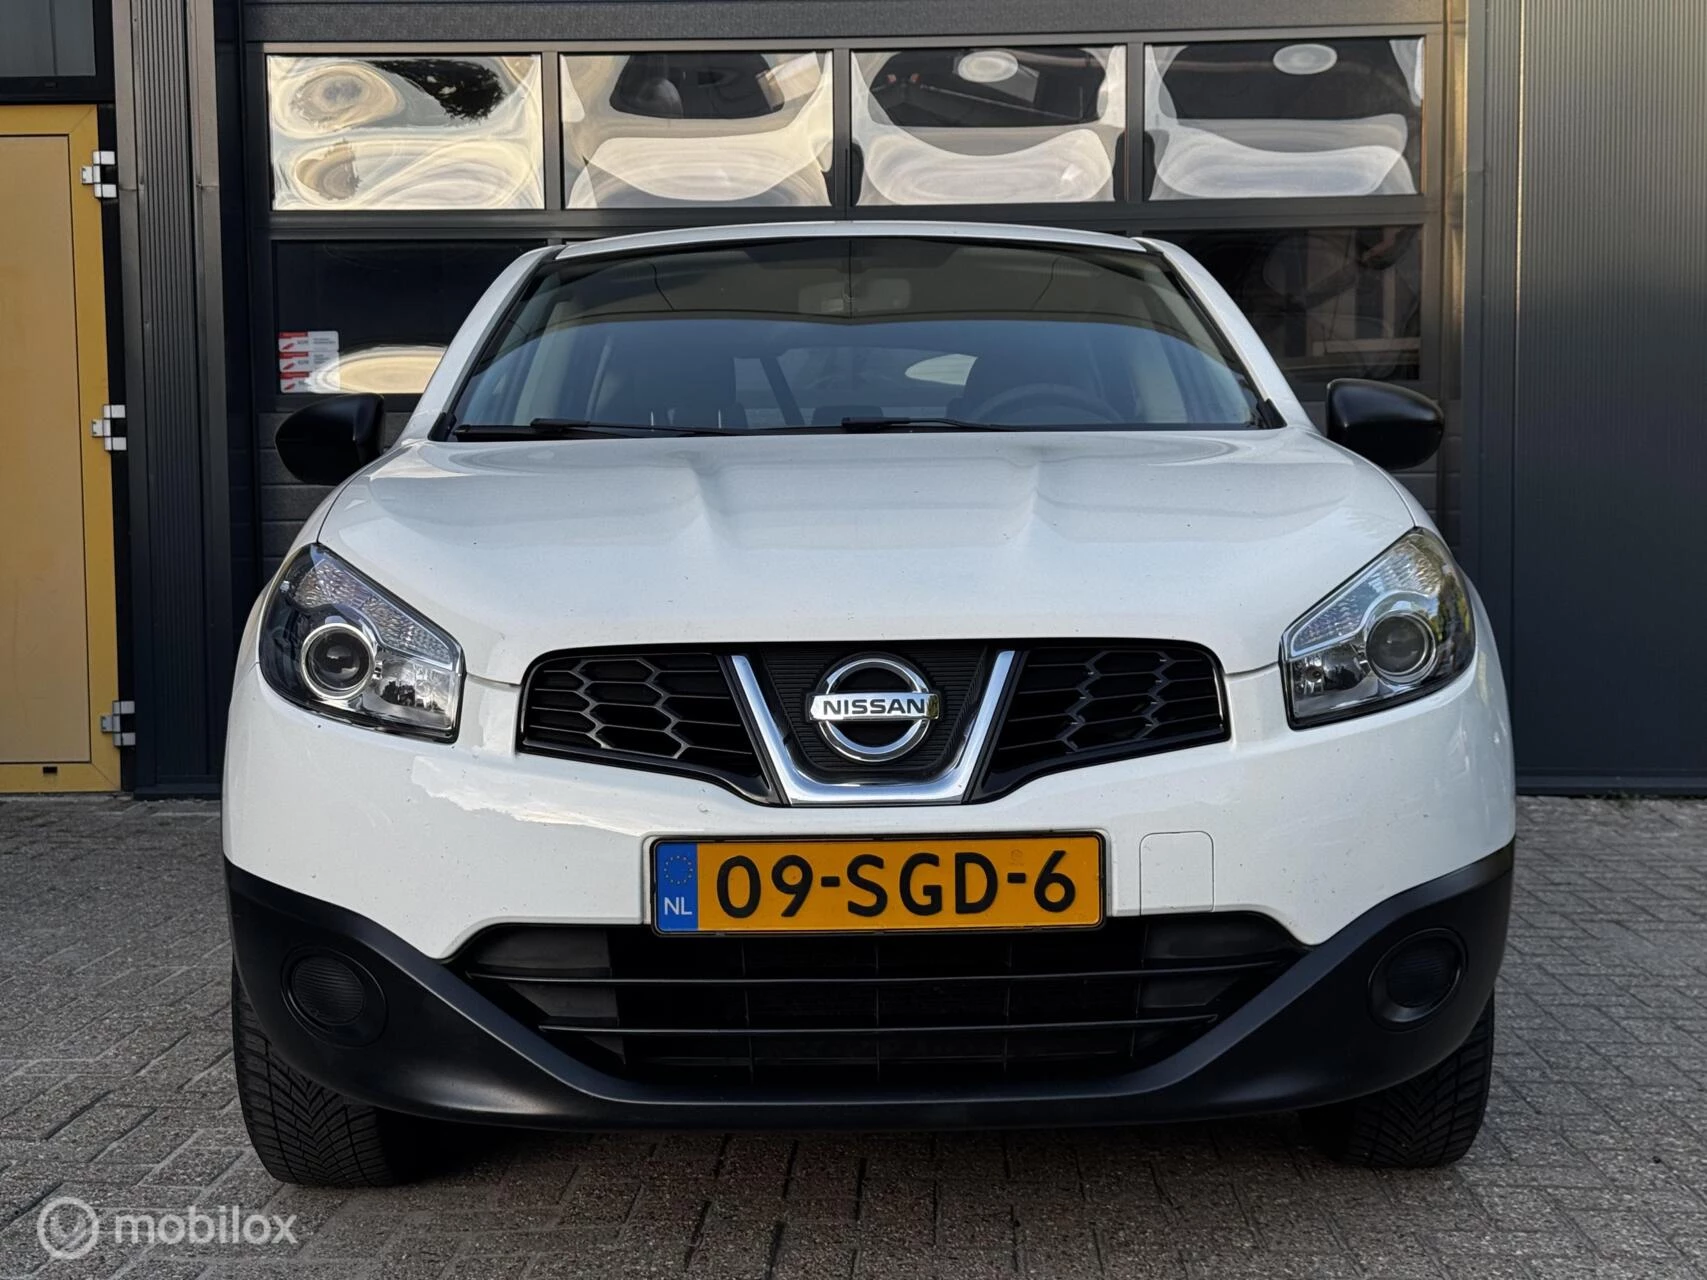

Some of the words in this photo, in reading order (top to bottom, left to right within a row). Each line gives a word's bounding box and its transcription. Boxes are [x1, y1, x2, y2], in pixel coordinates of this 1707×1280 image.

[823, 698, 925, 716] NISSAN
[715, 849, 1077, 920] 09-SGD-6
[663, 896, 693, 916] NL
